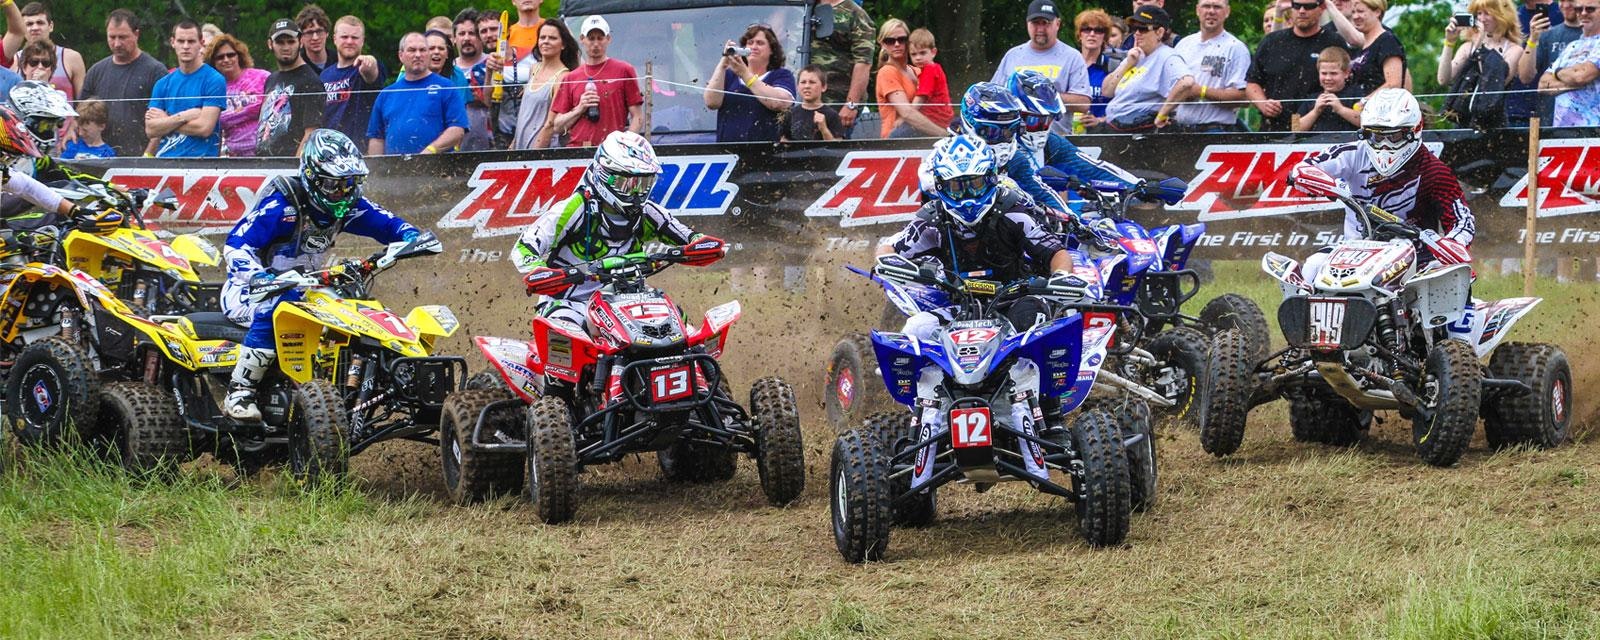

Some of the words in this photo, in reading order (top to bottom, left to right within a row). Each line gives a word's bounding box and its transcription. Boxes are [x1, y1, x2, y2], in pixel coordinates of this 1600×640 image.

[1195, 232, 1225, 246] he
[1229, 231, 1282, 246] First
[1287, 231, 1308, 246] in
[1517, 228, 1556, 243] Te
[460, 248, 502, 263] The
[955, 329, 986, 341] 12
[655, 370, 687, 397] 13
[953, 412, 988, 443] 12
